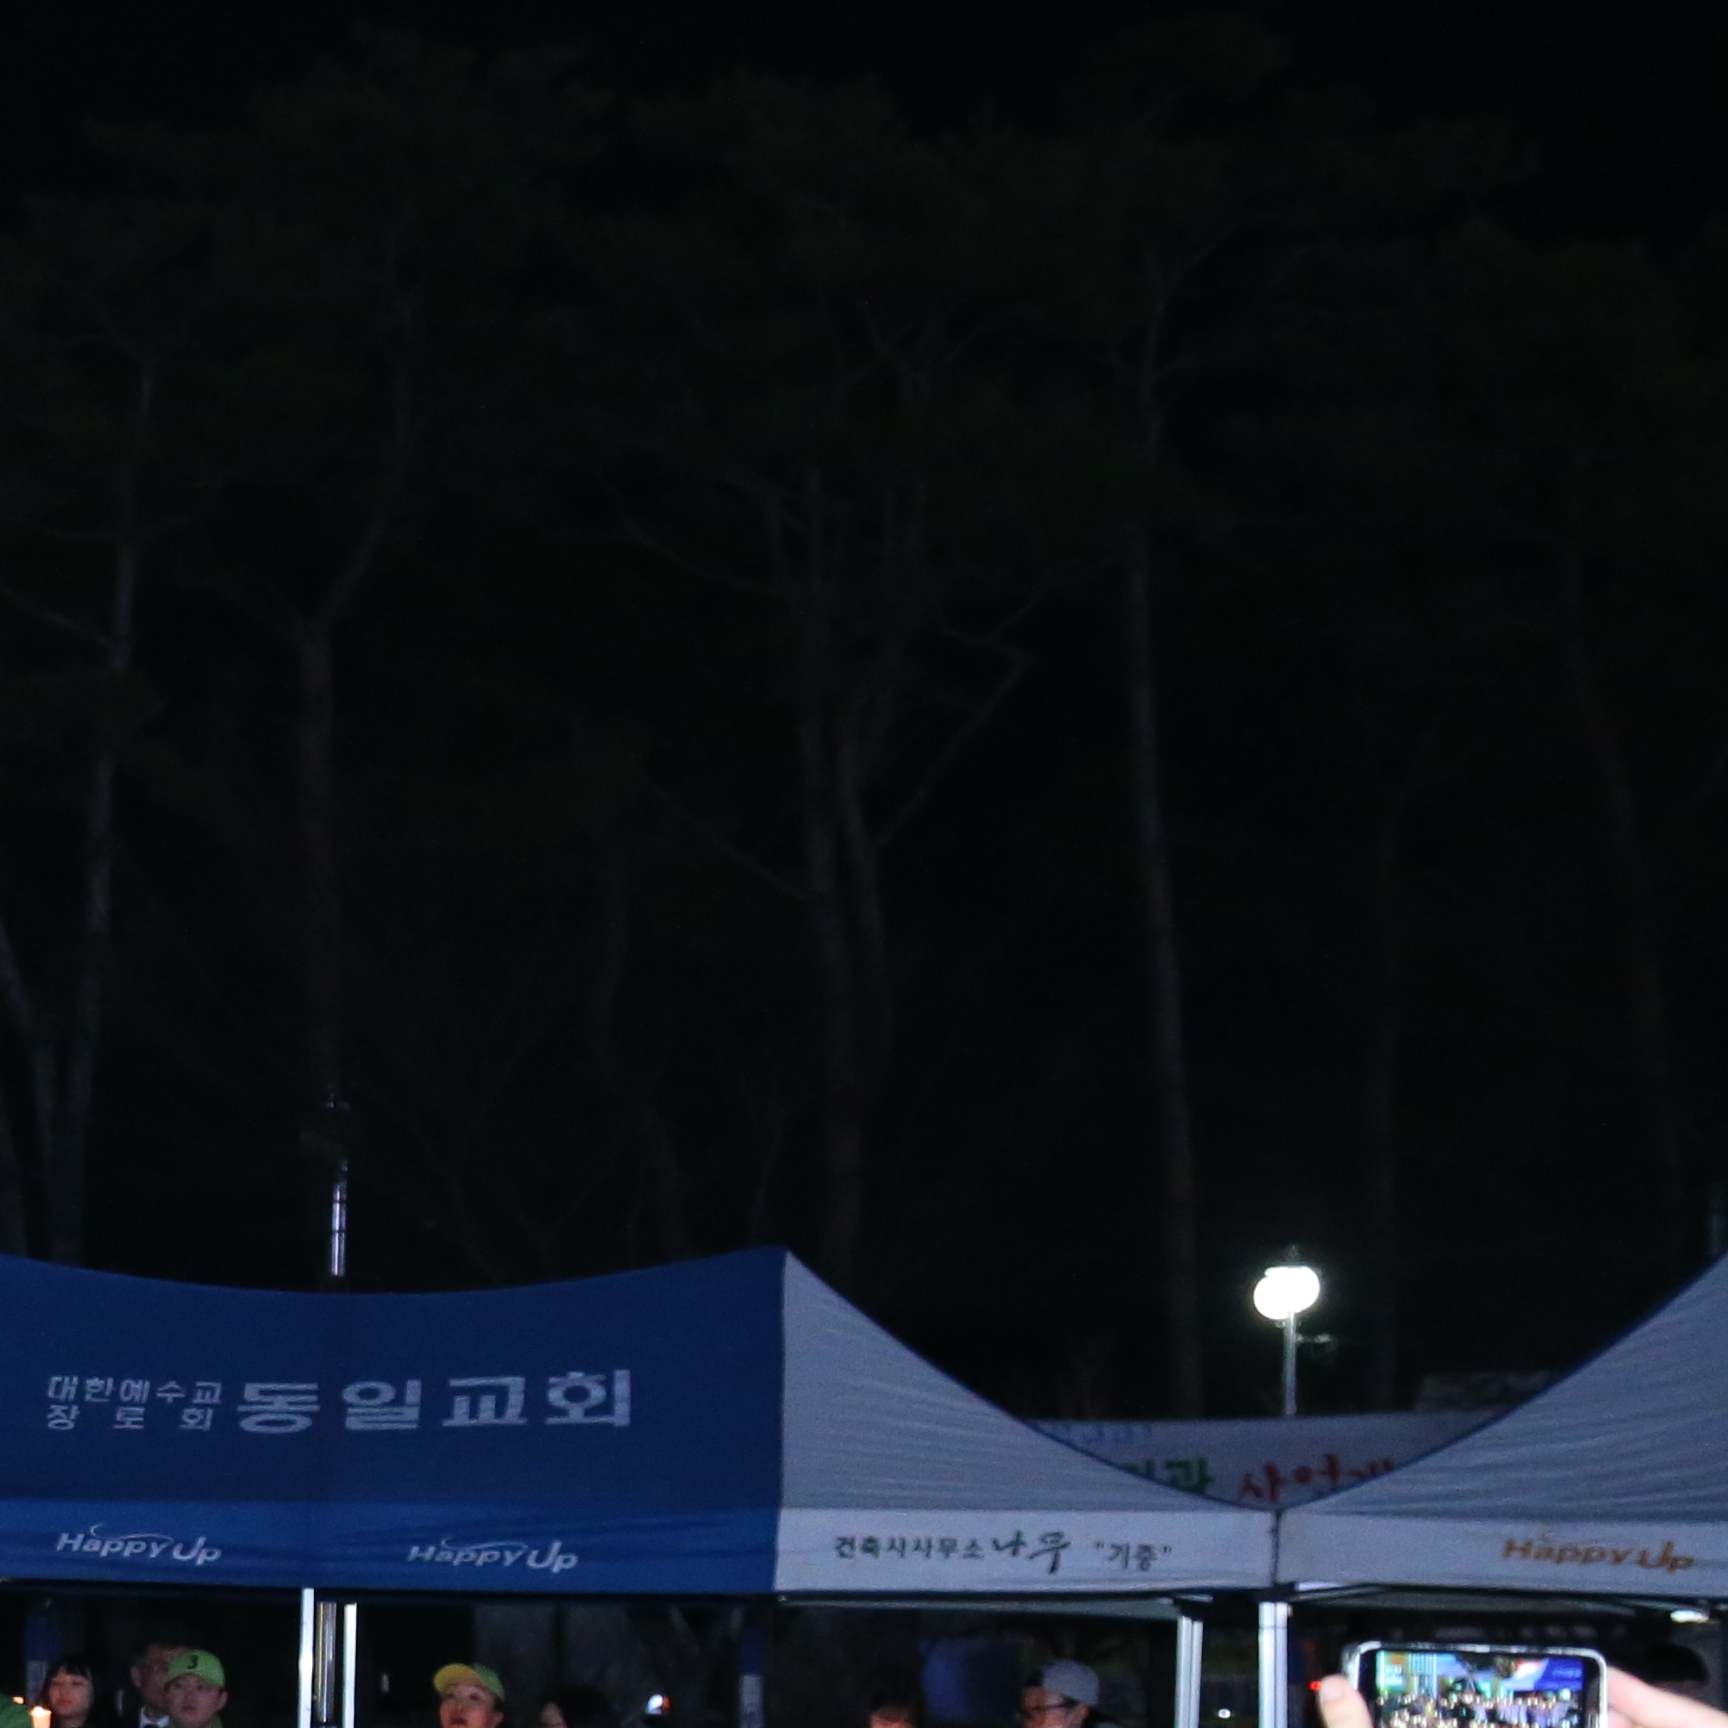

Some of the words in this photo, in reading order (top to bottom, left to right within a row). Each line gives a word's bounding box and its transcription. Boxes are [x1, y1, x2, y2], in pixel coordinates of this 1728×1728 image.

[47, 1375, 223, 1405] 대한예수교
[236, 1369, 632, 1434] 동일교회
[56, 1532, 171, 1559] Happy
[172, 1536, 222, 1566] Up
[407, 1545, 524, 1567] Happy
[526, 1539, 579, 1574] Up
[834, 1535, 986, 1560] 건축사사무소
[992, 1530, 1072, 1574] 나무
